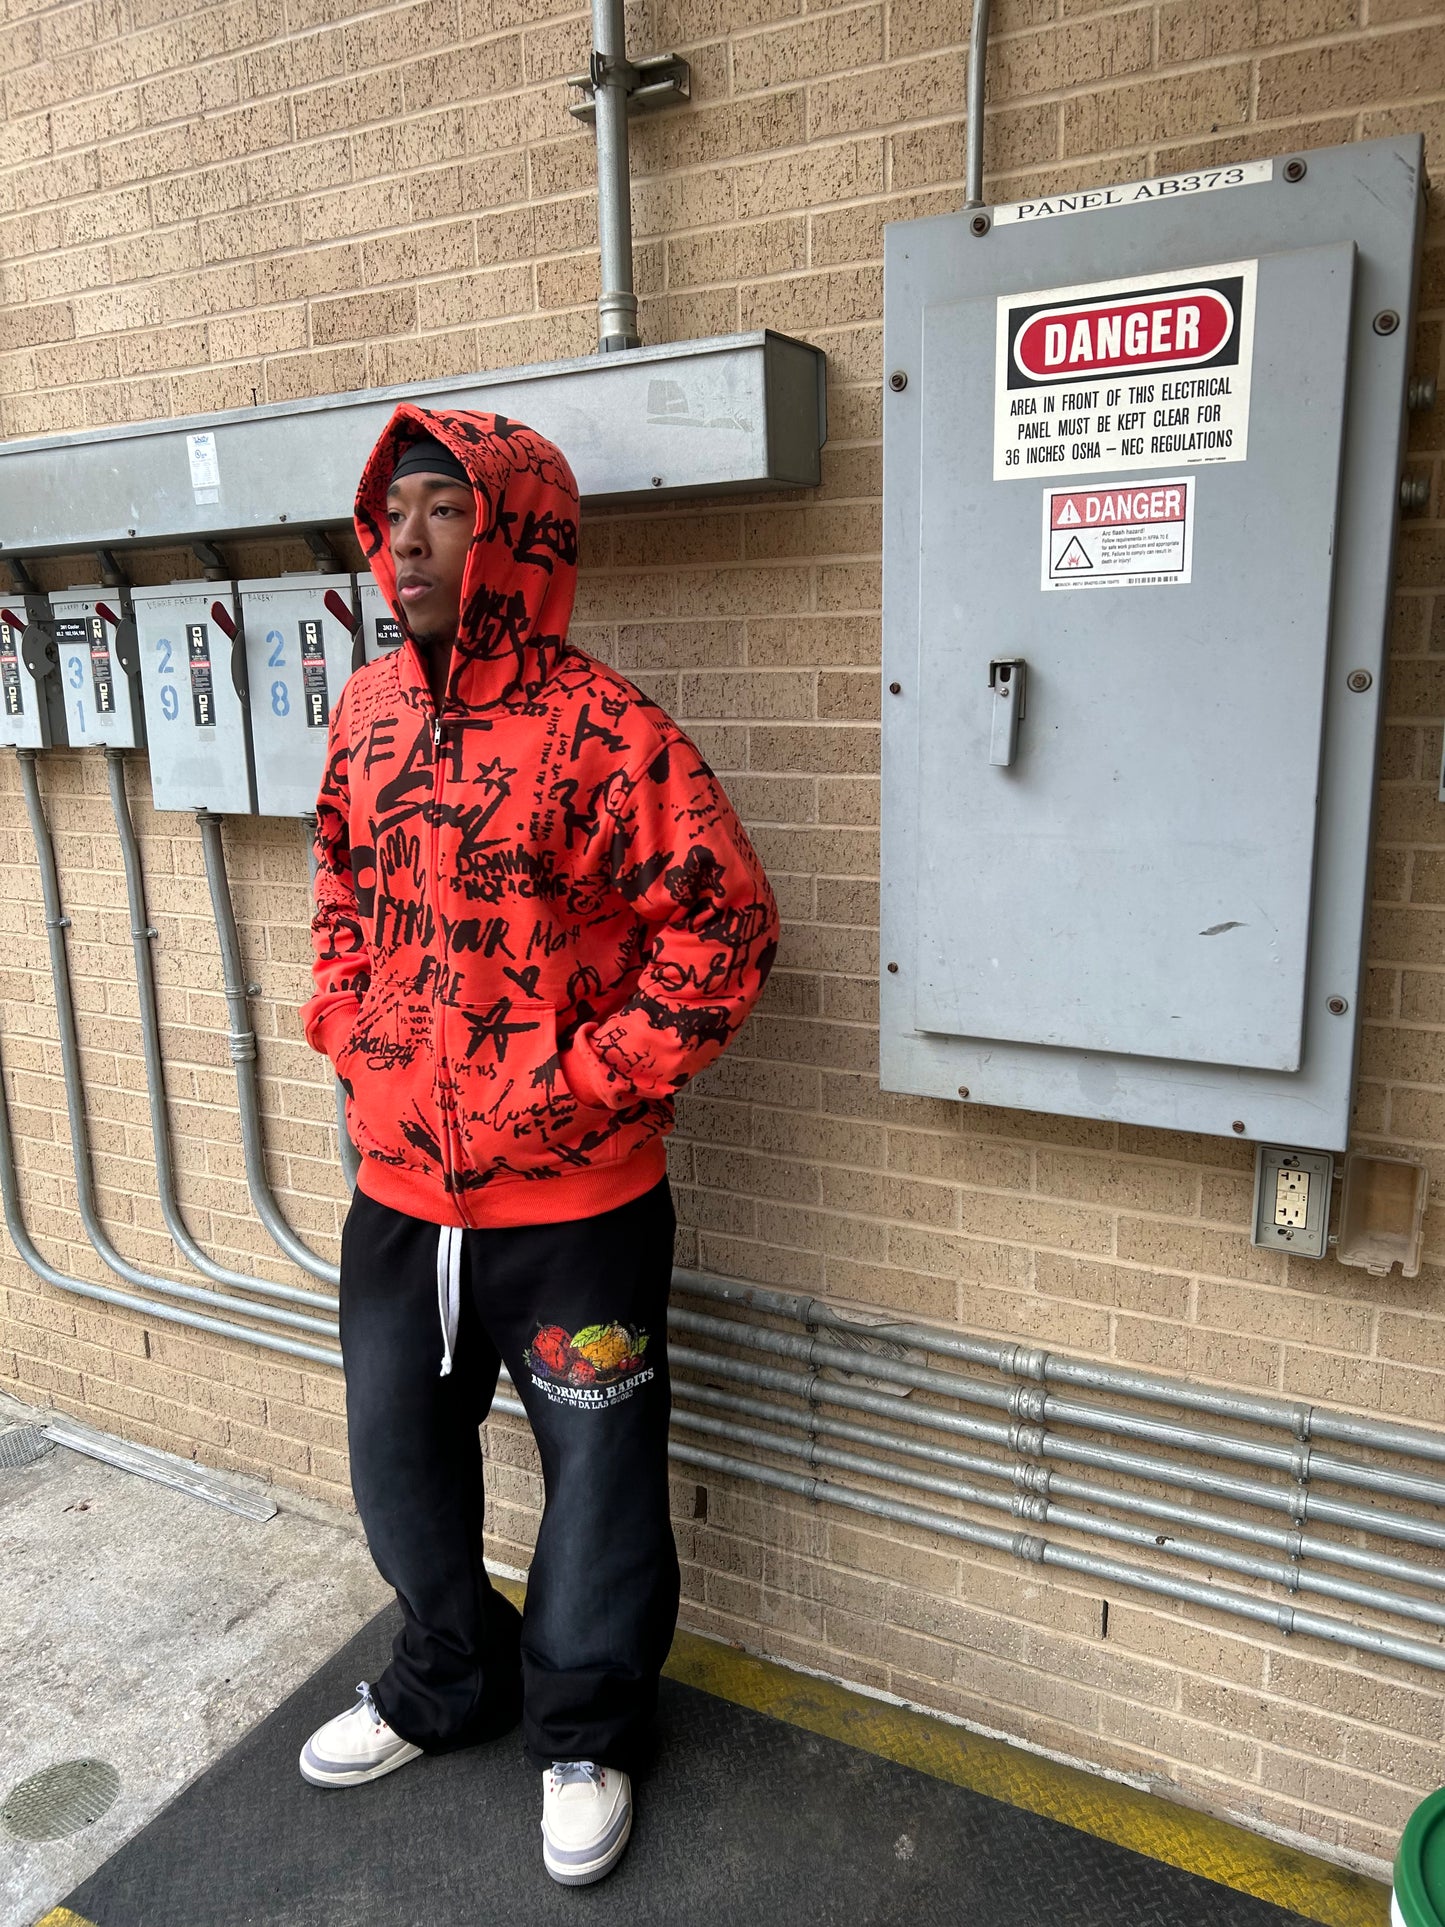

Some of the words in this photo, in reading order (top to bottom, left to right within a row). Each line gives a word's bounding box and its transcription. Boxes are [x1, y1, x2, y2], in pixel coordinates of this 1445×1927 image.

[1016, 190, 1123, 220] PANEL
[1132, 168, 1245, 201] AB373
[1044, 304, 1201, 367] DANGER
[1010, 398, 1037, 417] AREA
[1043, 396, 1055, 413] IN
[1062, 391, 1100, 411] FRONT
[1106, 389, 1122, 407] OF
[1129, 385, 1155, 405] THIS
[1161, 377, 1232, 401] ELECTRICAL
[1017, 422, 1051, 440] PANEL
[1058, 418, 1090, 437] MUST
[1097, 416, 1111, 433] BE
[1118, 412, 1146, 431] KEPT
[1153, 407, 1189, 428] CLEAR
[1197, 404, 1221, 424] FOR
[1005, 449, 1020, 466] 36
[1026, 444, 1065, 464] INCHES
[1072, 442, 1101, 460] OSHA
[1121, 437, 1144, 456] NEC
[1150, 429, 1233, 454] REGULATIONS
[1085, 489, 1181, 523] DANGER
[1, 624, 11, 644] ON
[92, 618, 103, 638] ON
[192, 626, 203, 648] ON
[305, 622, 318, 645] ON
[8, 686, 18, 714] OFF
[100, 683, 110, 711] OFF
[198, 694, 209, 724] OFF
[311, 694, 323, 725] OFF
[463, 875, 507, 905] NOT
[531, 1373, 604, 1401] ABNORMAL
[606, 1367, 655, 1399] HABITS
